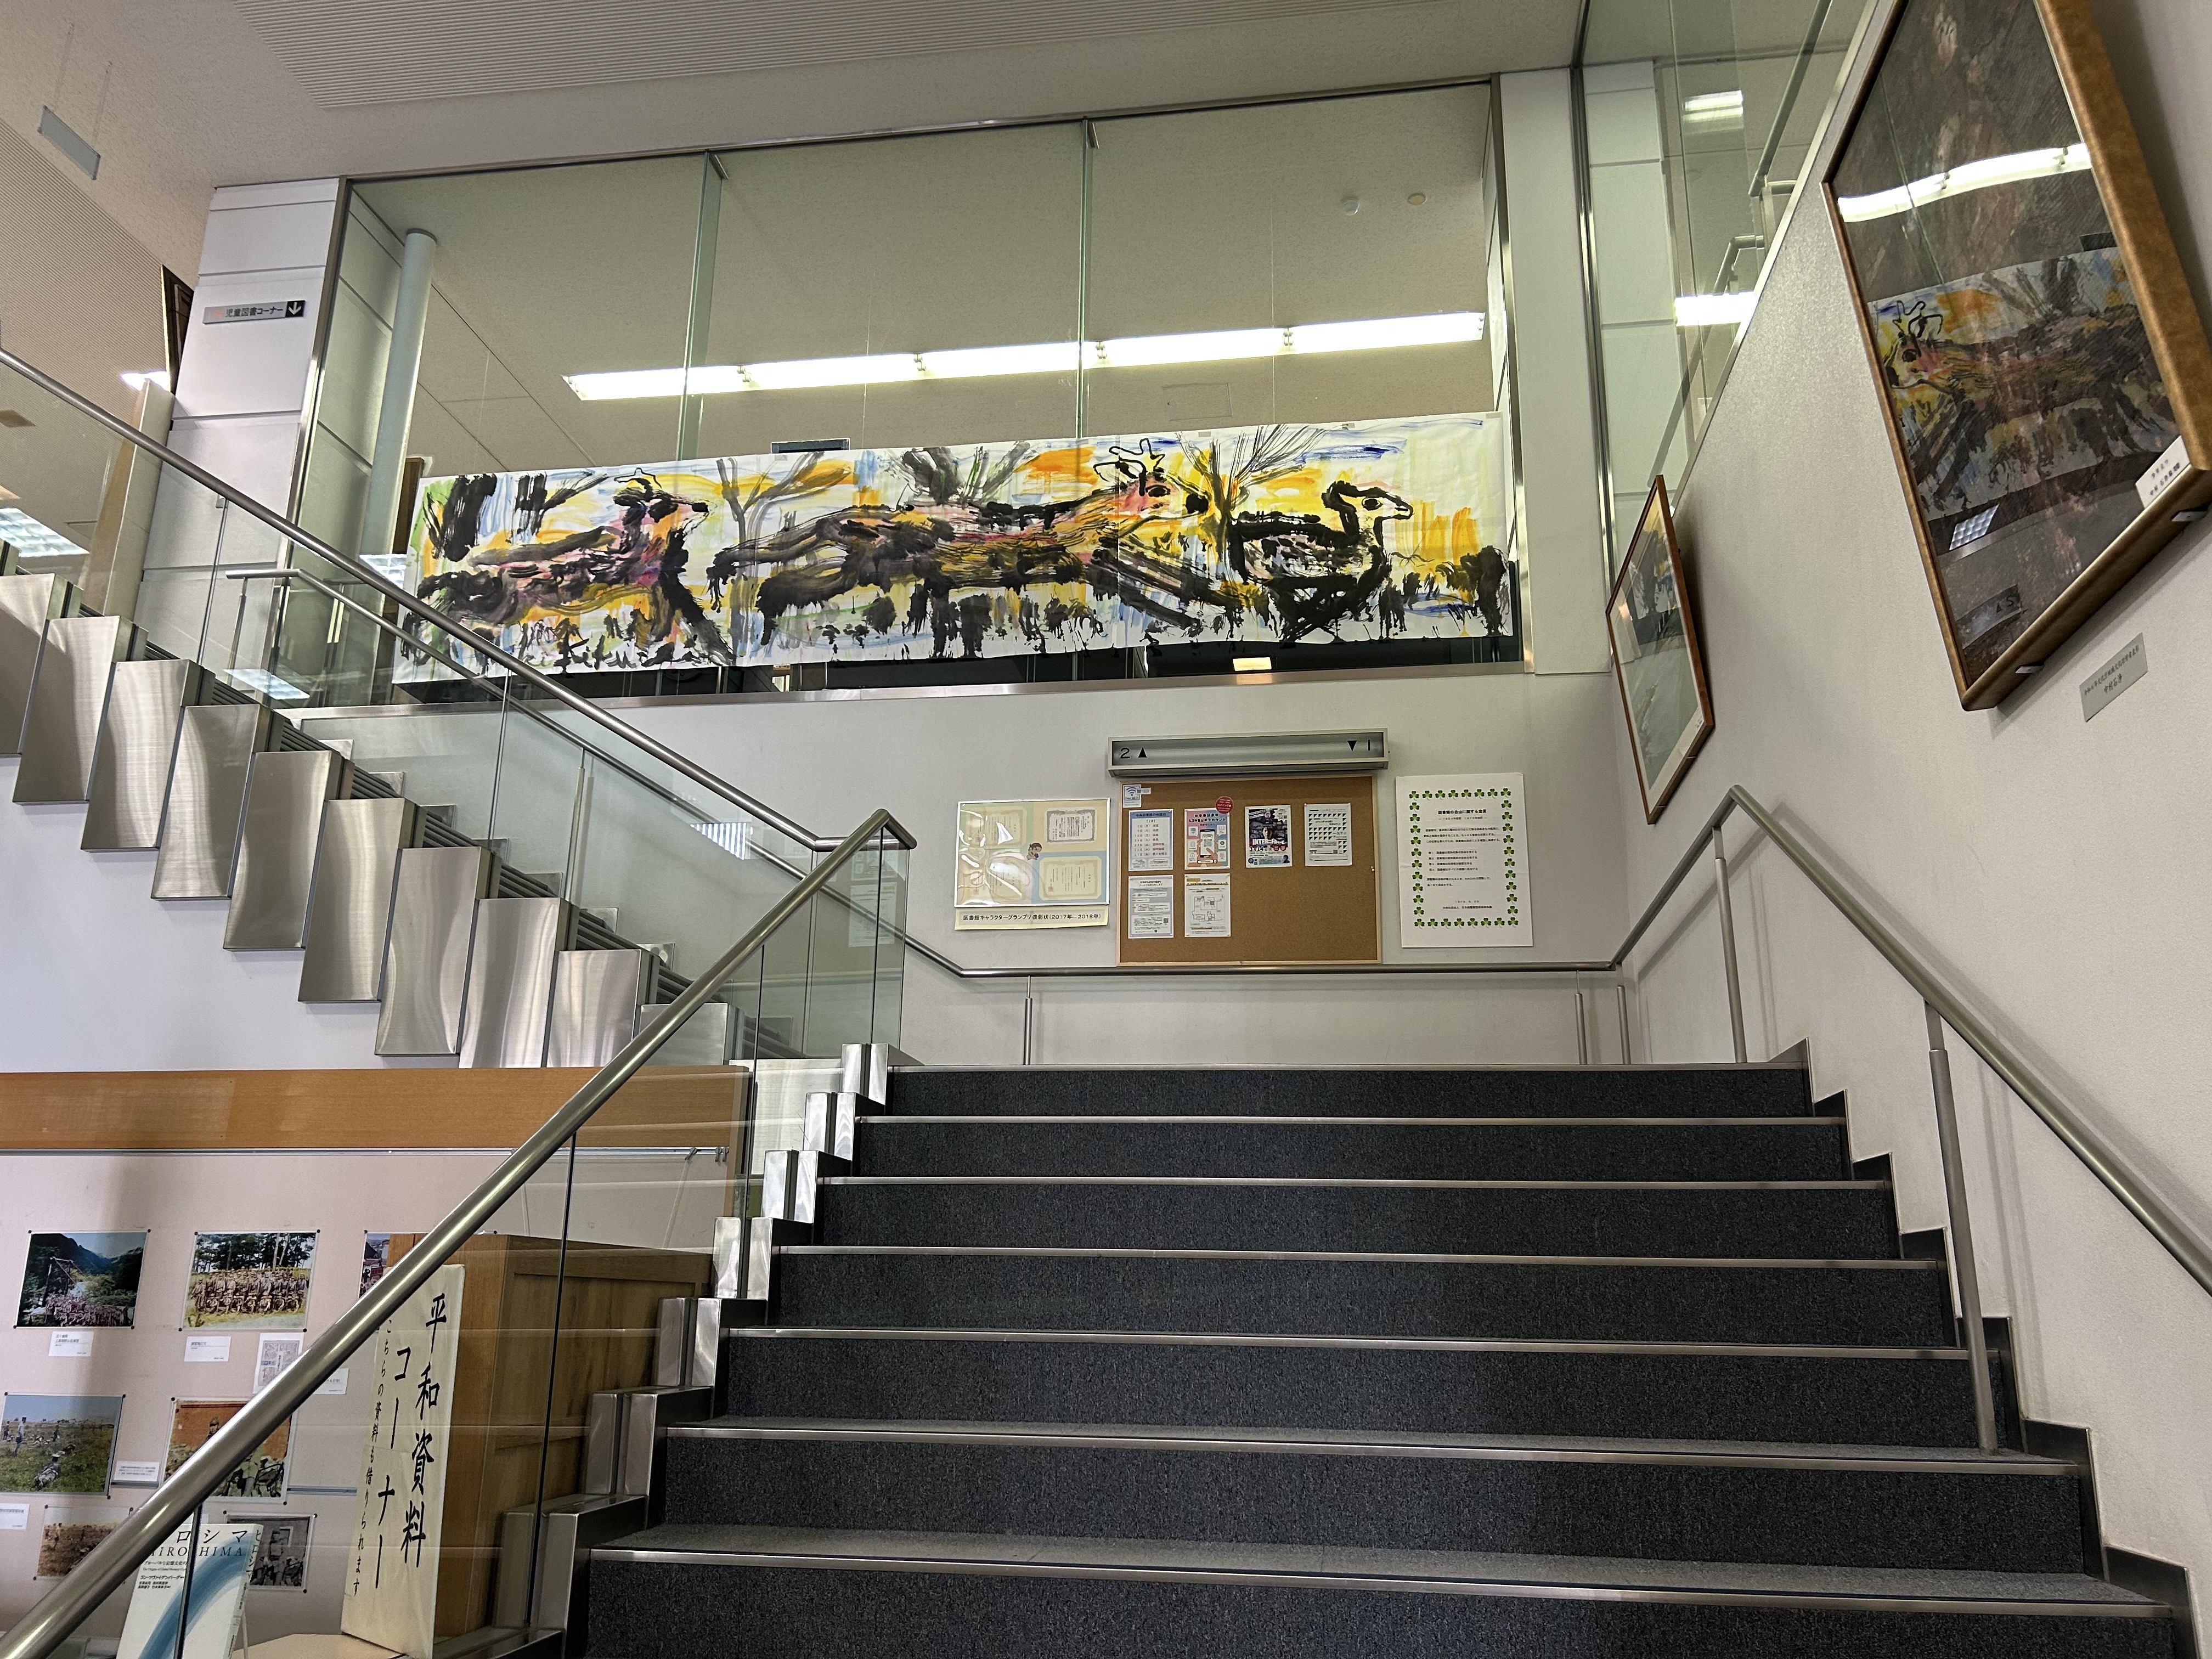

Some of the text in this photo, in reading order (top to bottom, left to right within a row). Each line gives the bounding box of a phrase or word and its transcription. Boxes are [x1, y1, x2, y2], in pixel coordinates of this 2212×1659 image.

[225, 307, 283, 317] 児童図書コーナー
[1120, 747, 1130, 759] 2
[404, 1293, 447, 1568] 平和資料
[353, 1319, 392, 1597] こちらの資料も借りられます
[375, 1347, 411, 1589] コーナー
[177, 1530, 247, 1543] ロシマ
[151, 1547, 242, 1557] IROHIMA
